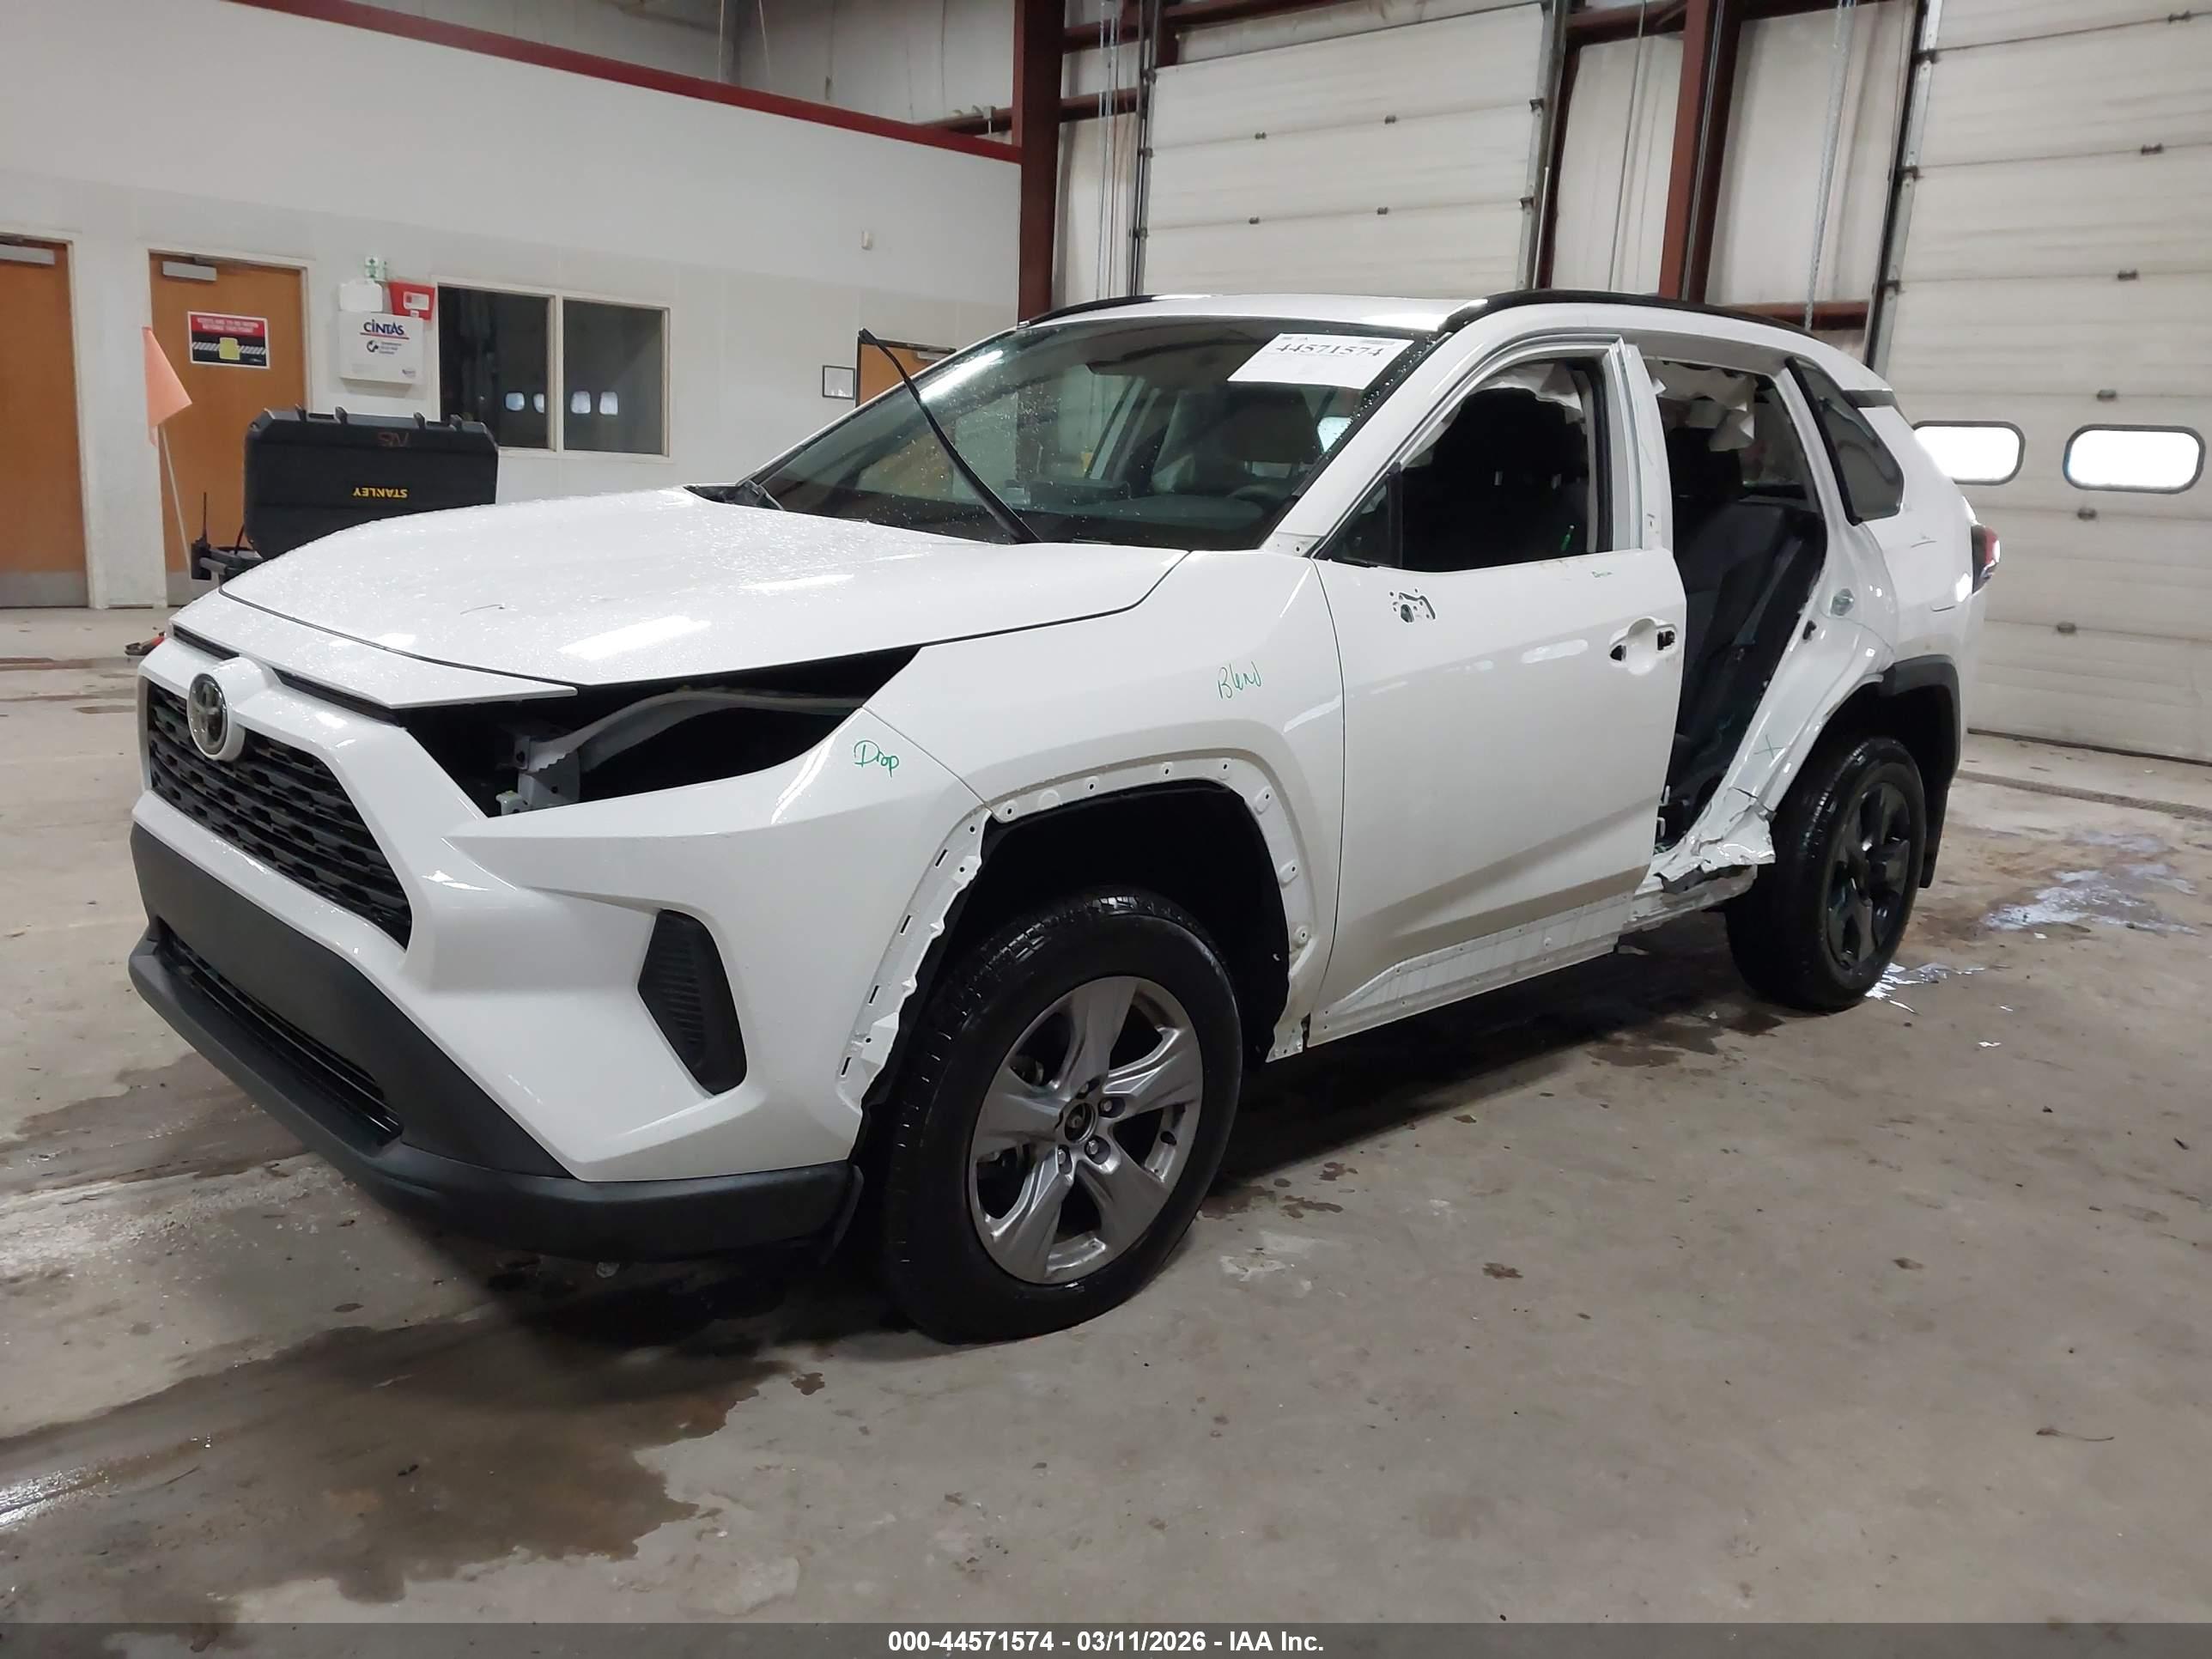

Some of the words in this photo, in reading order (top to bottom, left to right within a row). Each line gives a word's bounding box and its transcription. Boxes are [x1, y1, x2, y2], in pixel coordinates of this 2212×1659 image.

[1275, 343, 1383, 356] 44571574
[352, 487, 409, 498] STANLEY
[854, 740, 899, 778] Drop
